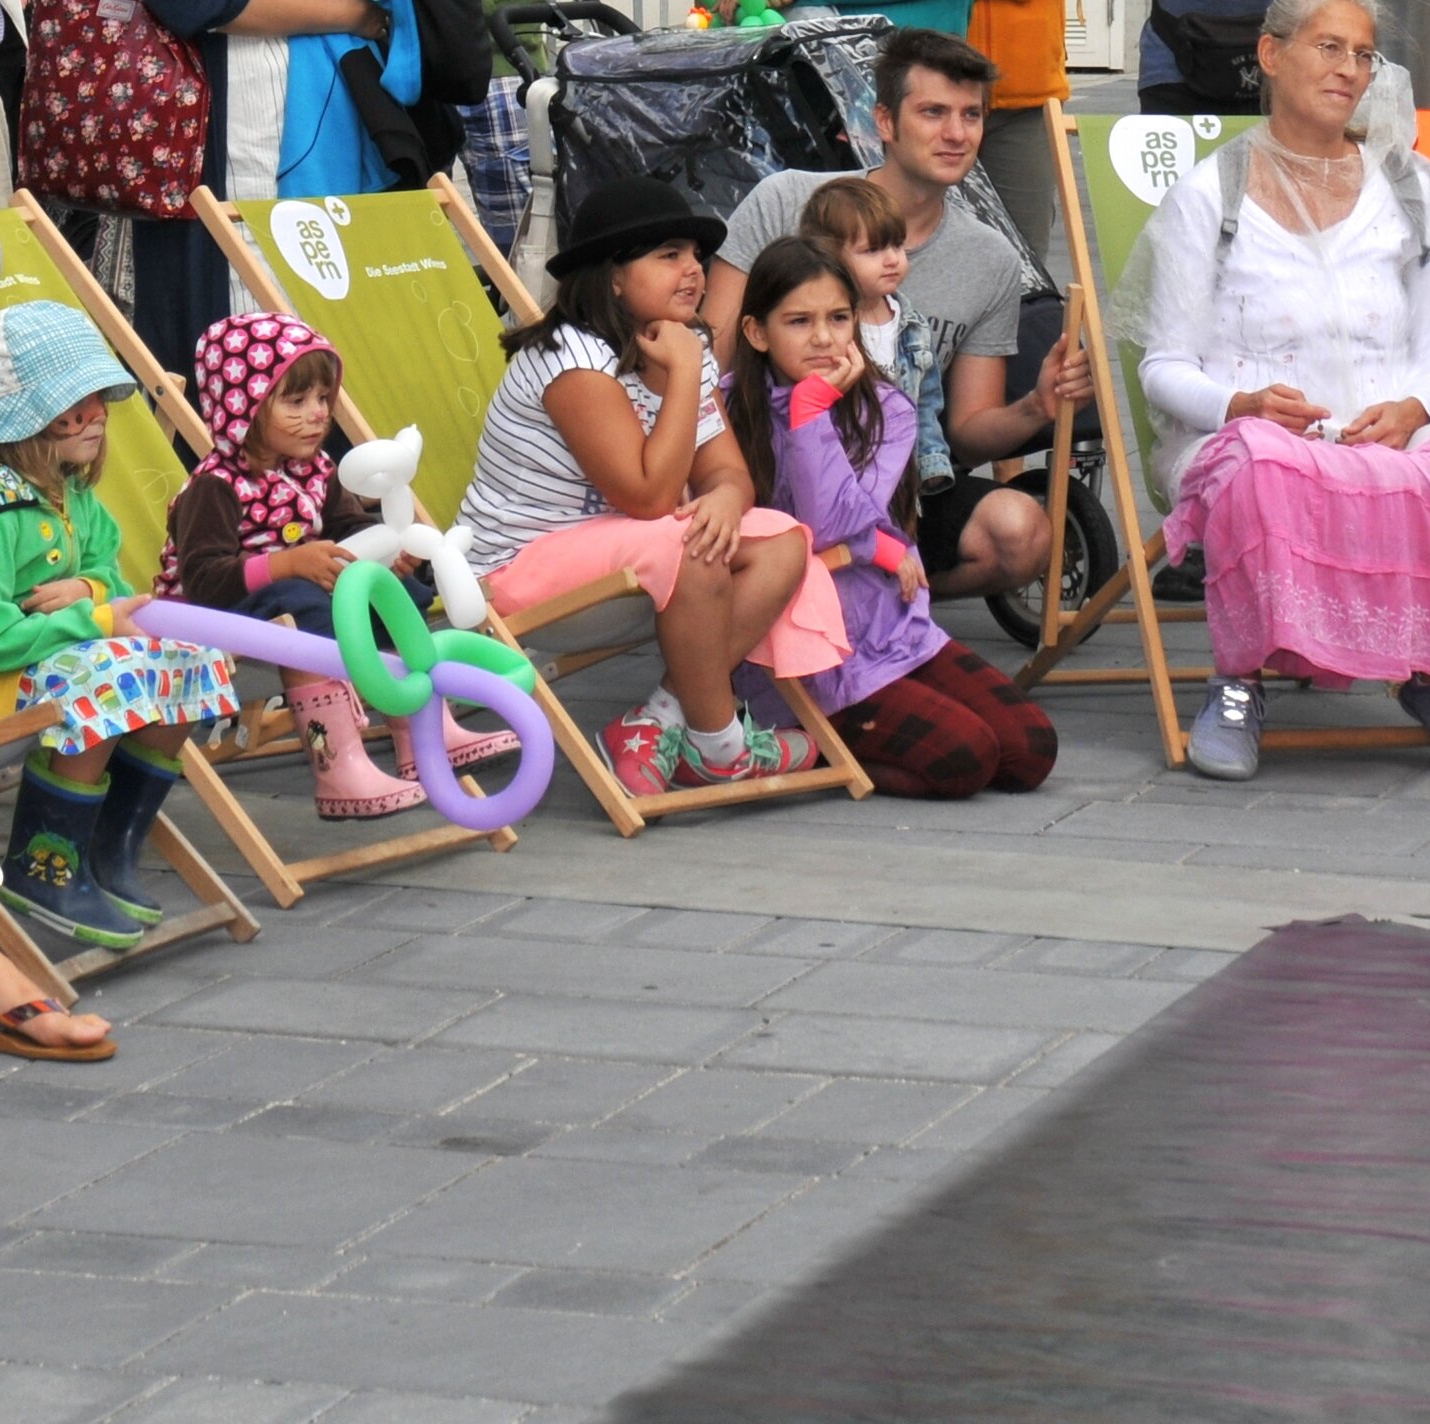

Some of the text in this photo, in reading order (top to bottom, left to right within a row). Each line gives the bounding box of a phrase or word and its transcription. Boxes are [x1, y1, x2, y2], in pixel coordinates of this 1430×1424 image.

[1145, 130, 1178, 149] as
[1140, 150, 1176, 174] pe
[1151, 170, 1179, 187] rn
[296, 219, 324, 240] as
[299, 240, 330, 266] pe
[315, 260, 342, 280] rn
